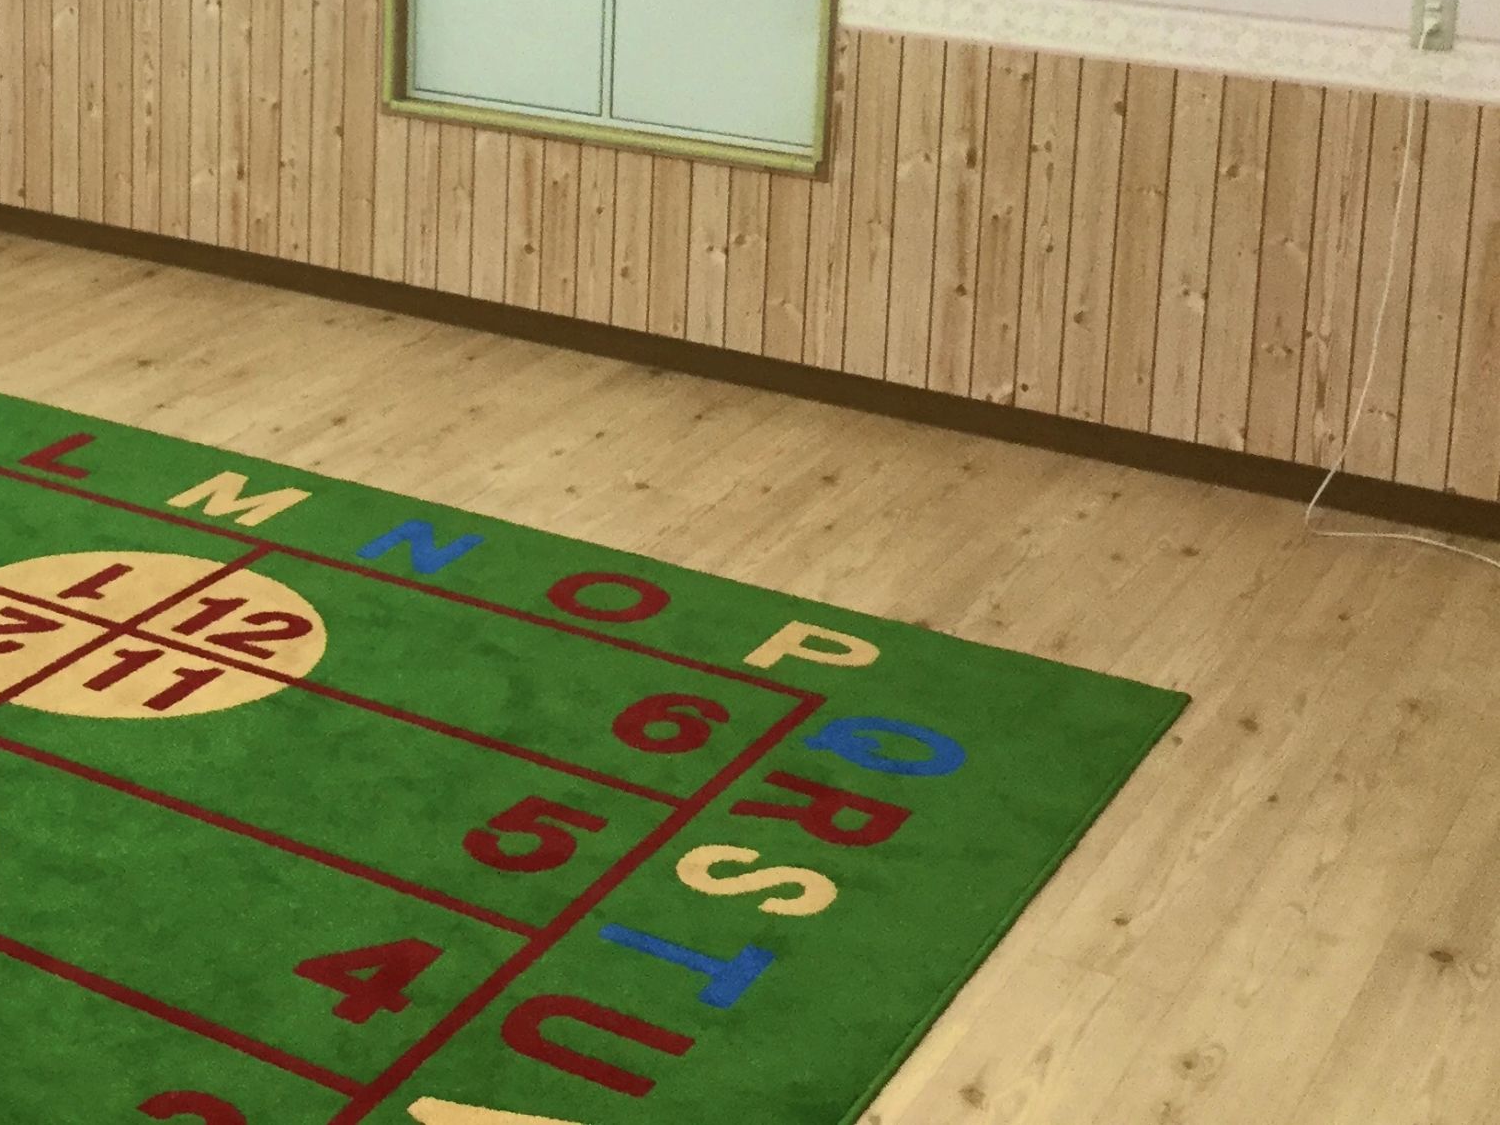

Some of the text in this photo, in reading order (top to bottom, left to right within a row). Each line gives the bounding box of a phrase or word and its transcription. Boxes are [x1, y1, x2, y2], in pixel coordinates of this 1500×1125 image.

[20, 433, 97, 477] L
[167, 471, 311, 526] M
[357, 519, 484, 574] N
[546, 572, 671, 623] O
[743, 621, 880, 668] P
[173, 597, 313, 659] 12
[82, 649, 225, 710] 11
[612, 693, 730, 753] 6
[463, 796, 608, 872] 5
[501, 717, 966, 1097] Q R S T U
[293, 938, 445, 1024] 4
